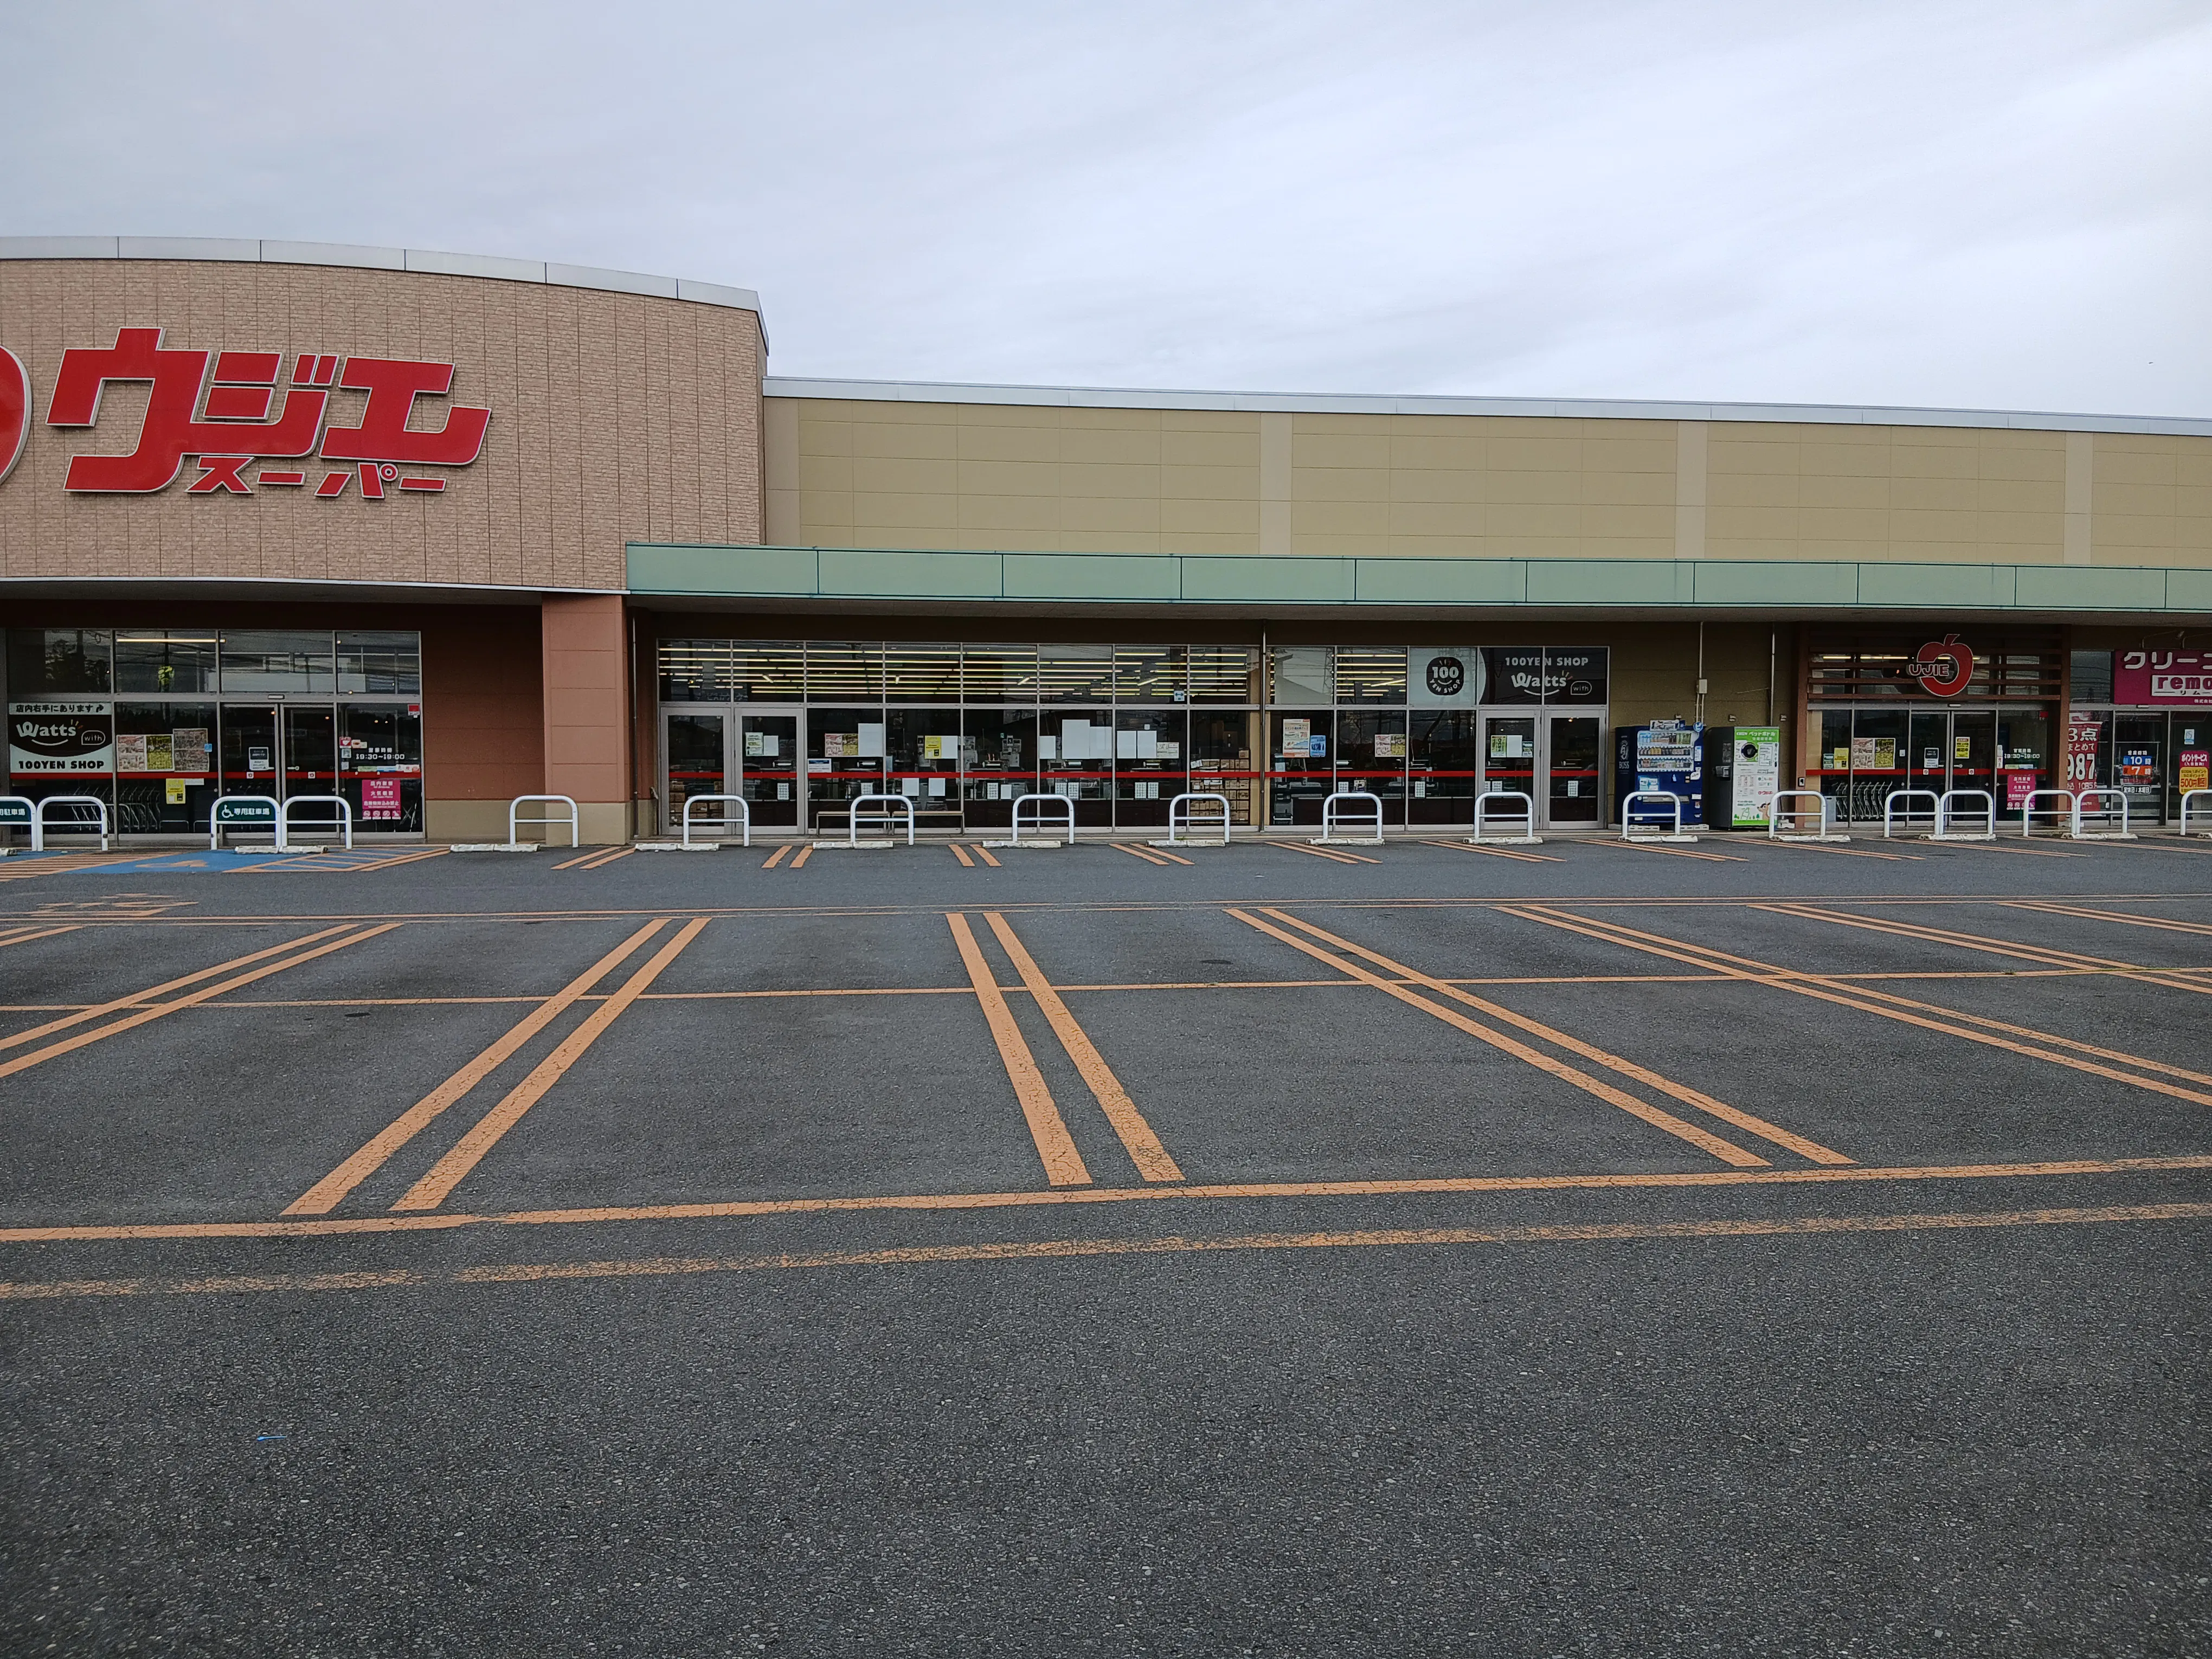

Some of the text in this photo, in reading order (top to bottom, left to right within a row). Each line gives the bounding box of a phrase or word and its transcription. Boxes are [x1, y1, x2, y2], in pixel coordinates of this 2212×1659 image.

[46, 326, 492, 493] ウジエ
[185, 455, 447, 499] スーパー
[1505, 657, 1552, 666] 100YEN
[1557, 657, 1589, 666] SHOP
[1432, 666, 1459, 679] 100
[1908, 664, 1950, 677] UJIE
[1430, 678, 1461, 693] YEN SHOP
[1511, 672, 1566, 687] Watts
[16, 704, 93, 713] 店内右手にあります
[16, 721, 76, 737] Watts
[2067, 743, 2095, 752] まとめて
[18, 761, 104, 769] 100YEN SHOP
